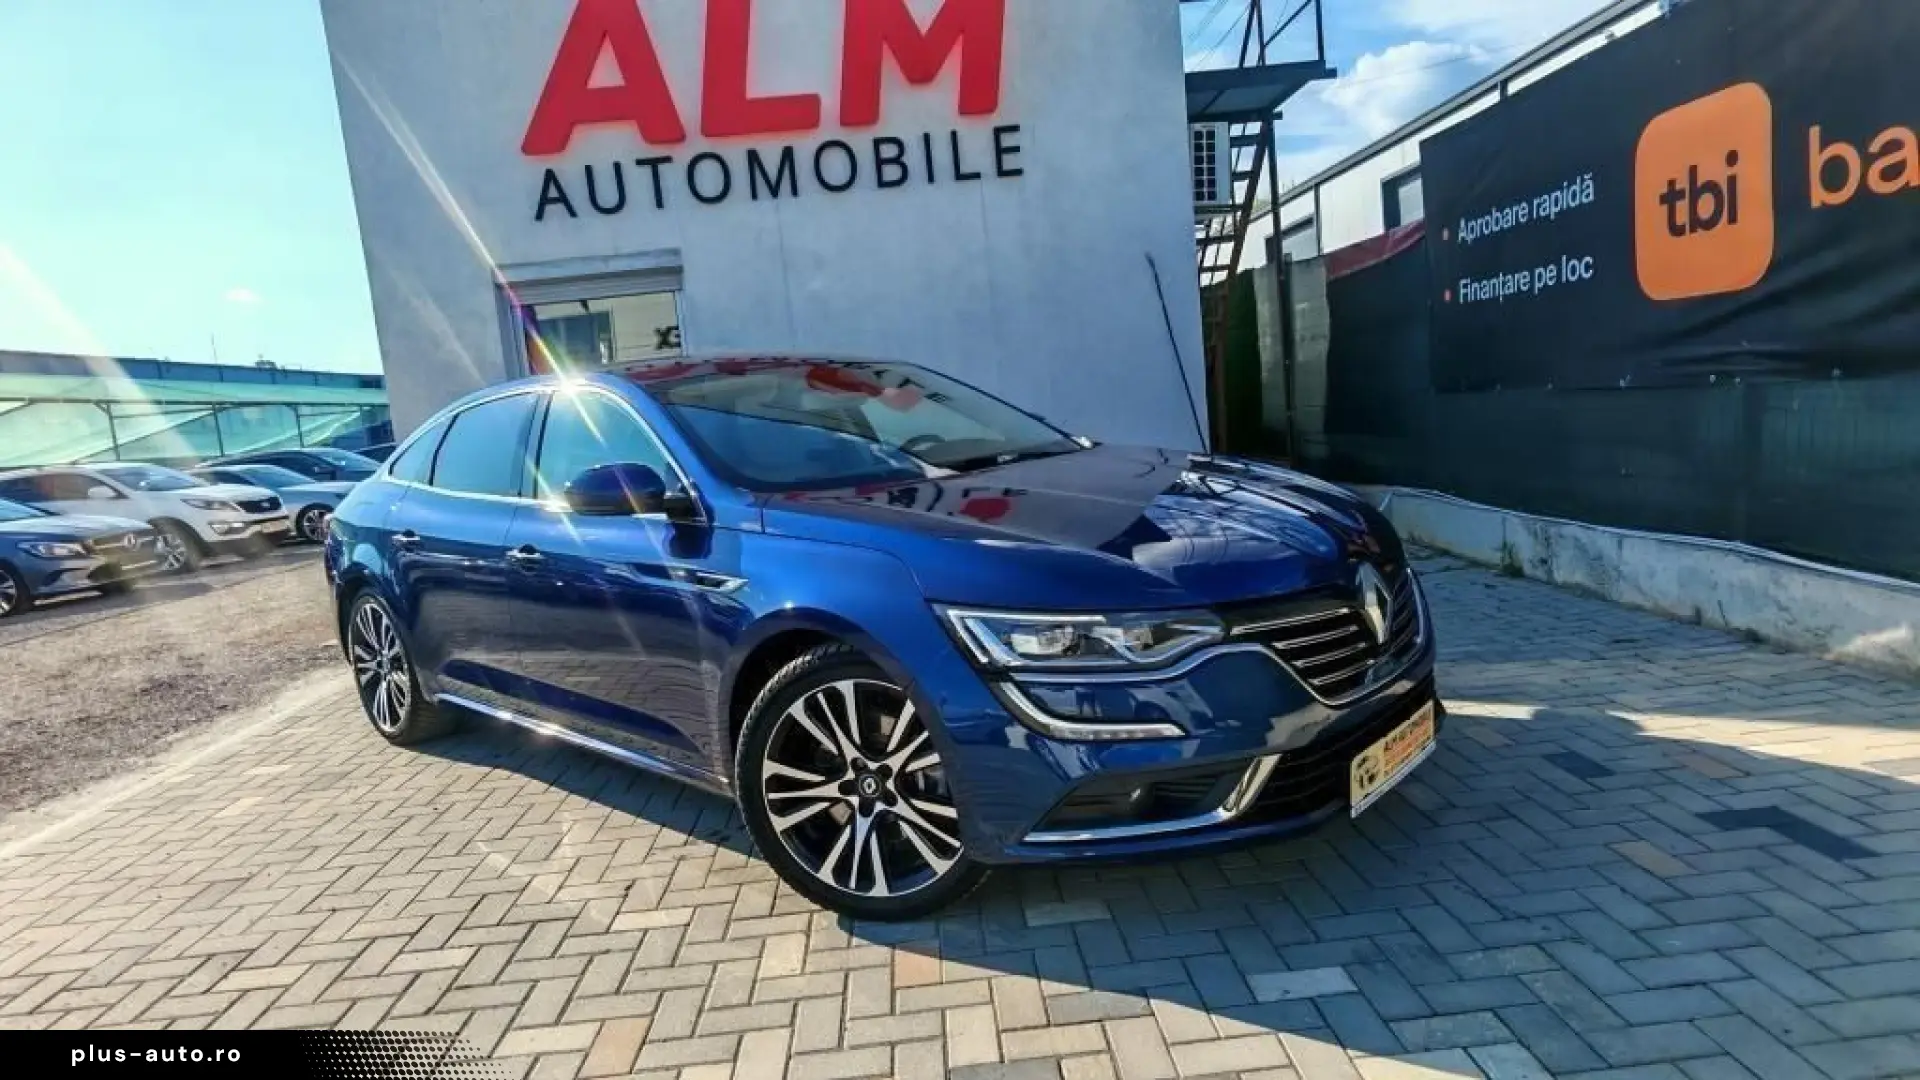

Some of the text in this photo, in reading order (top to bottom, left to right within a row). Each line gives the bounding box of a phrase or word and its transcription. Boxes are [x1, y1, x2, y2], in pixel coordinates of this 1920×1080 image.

[521, 0, 1005, 155] ALM
[535, 124, 1024, 221] AUTOMOBILE
[1458, 172, 1595, 245] Aprobare rapidă
[1659, 125, 1920, 237] tbi ba
[1459, 254, 1595, 305] Finanțare pe loc
